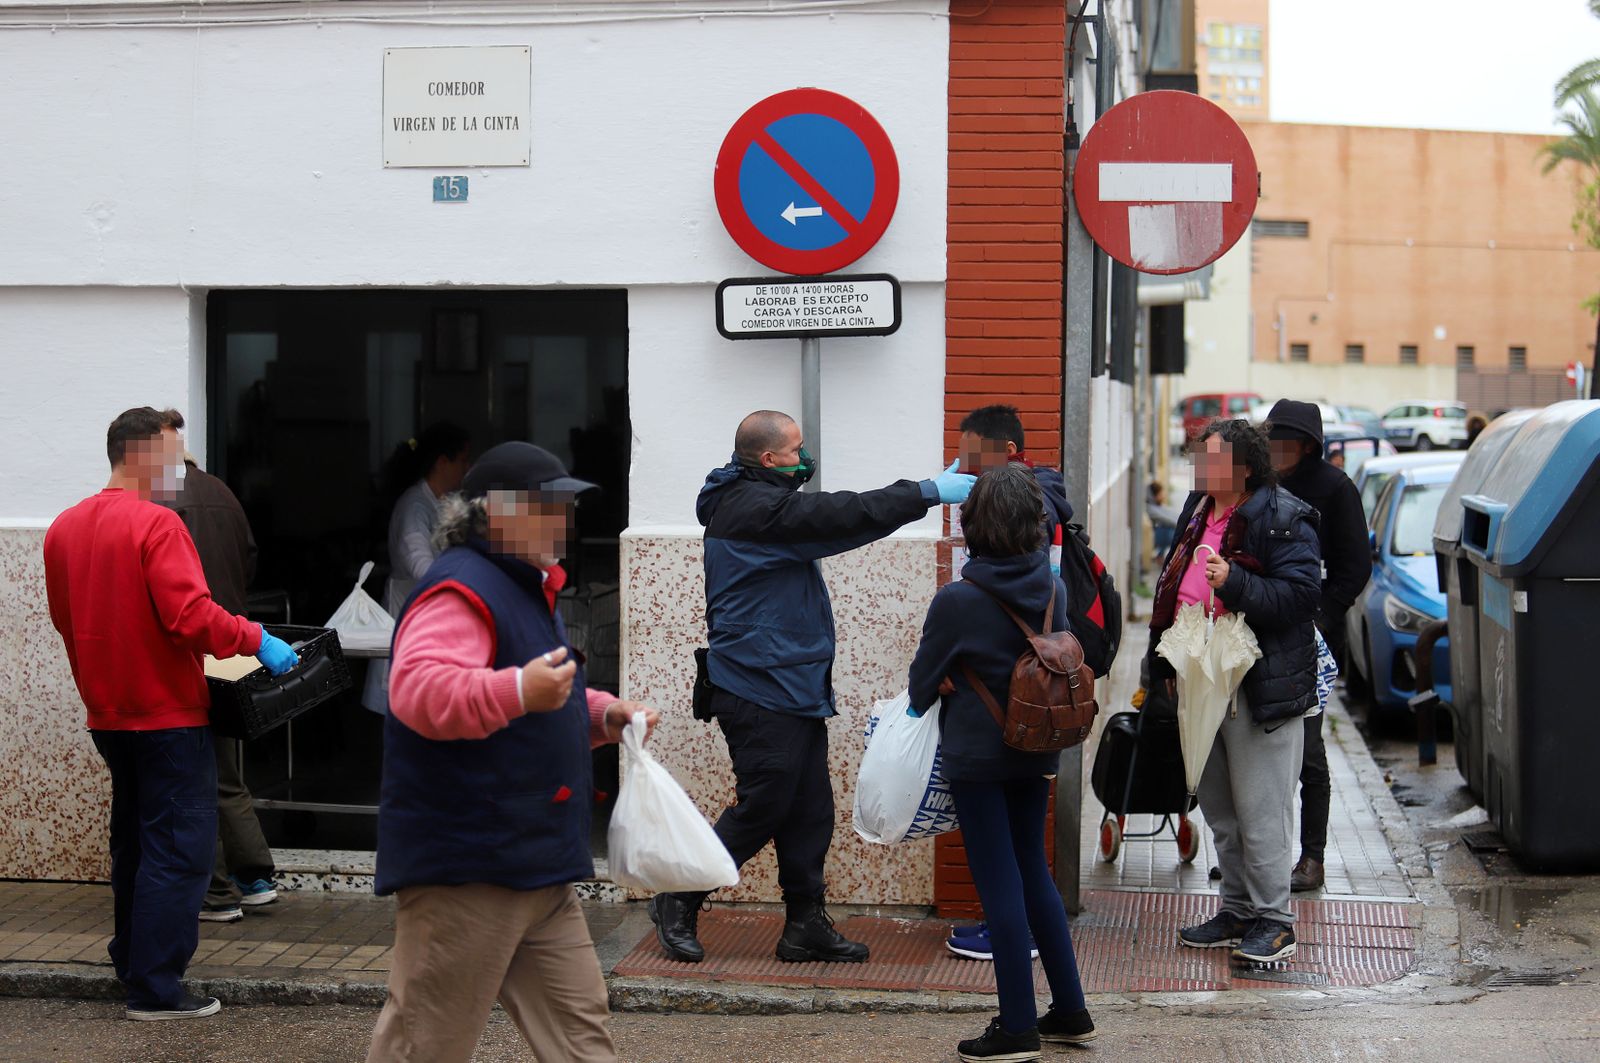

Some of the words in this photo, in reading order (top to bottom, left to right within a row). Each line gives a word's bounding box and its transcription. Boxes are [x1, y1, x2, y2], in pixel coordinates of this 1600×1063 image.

[428, 81, 485, 96] COMEDOR
[393, 117, 436, 131] VIRGEN
[442, 116, 457, 131] DE
[463, 116, 477, 131] LA
[484, 116, 519, 131] CINTA
[441, 176, 460, 198] 15
[756, 286, 767, 295] DE
[793, 285, 799, 294] A
[824, 284, 854, 294] HORAS
[820, 293, 869, 305] EXCEPTO
[754, 308, 792, 317] CARGA
[794, 308, 801, 316] Y
[803, 305, 863, 316] DESCARGA
[741, 319, 785, 329] COMEDOR
[787, 318, 820, 328] VIRGEN
[822, 318, 833, 327] DE
[836, 317, 847, 327] LA
[849, 316, 875, 326] CINTA
